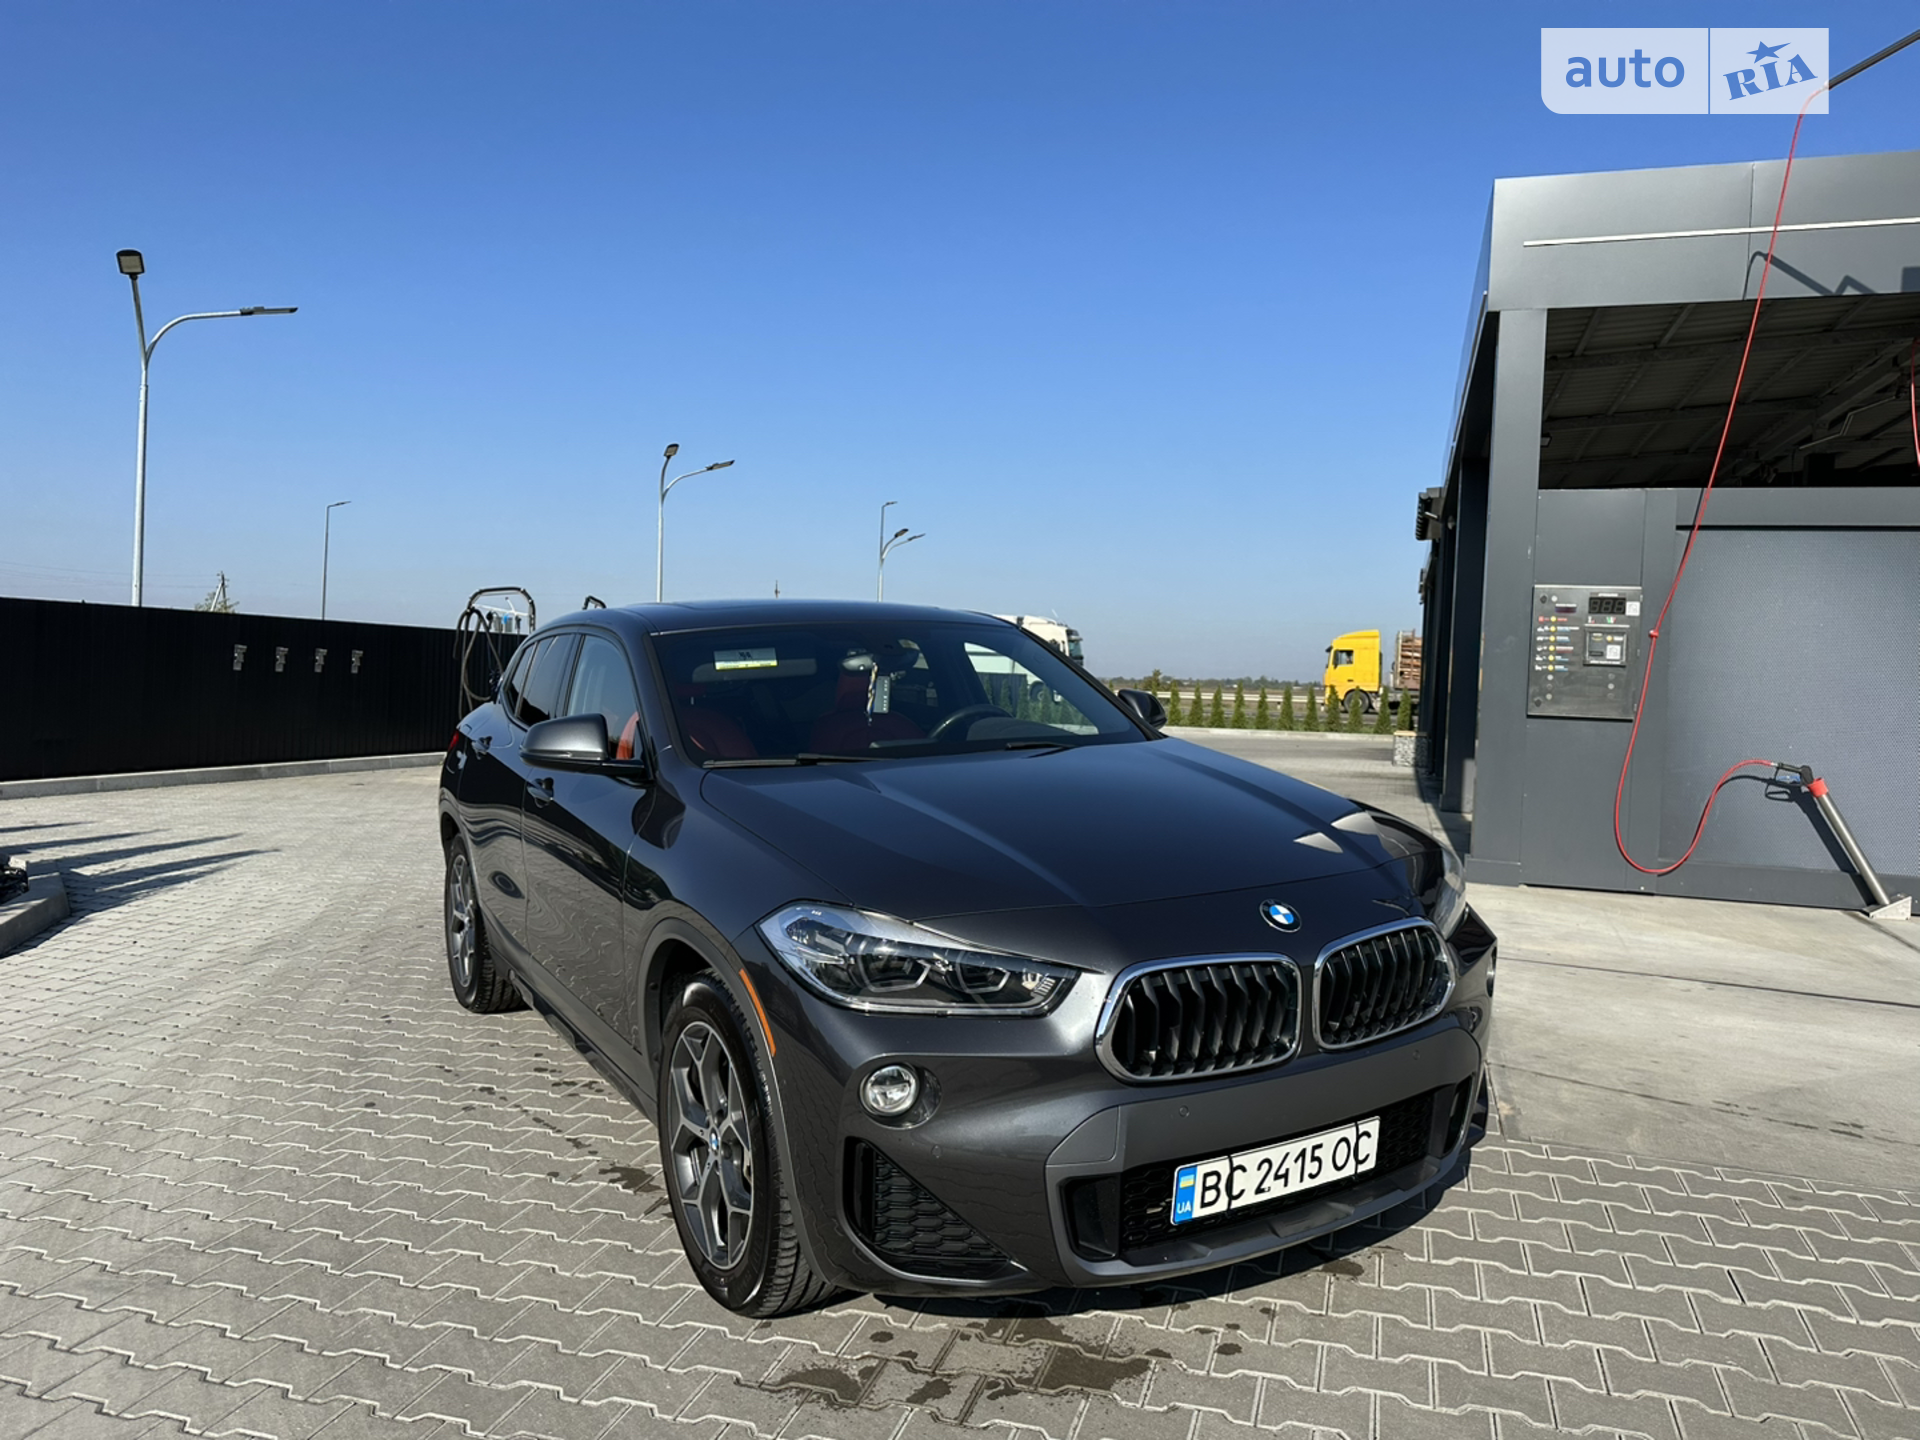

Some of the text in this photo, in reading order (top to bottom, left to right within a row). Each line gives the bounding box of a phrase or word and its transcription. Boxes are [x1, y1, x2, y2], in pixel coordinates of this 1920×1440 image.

[1200, 1130, 1373, 1209] BC 2415 OC
[1176, 1201, 1192, 1214] UA
